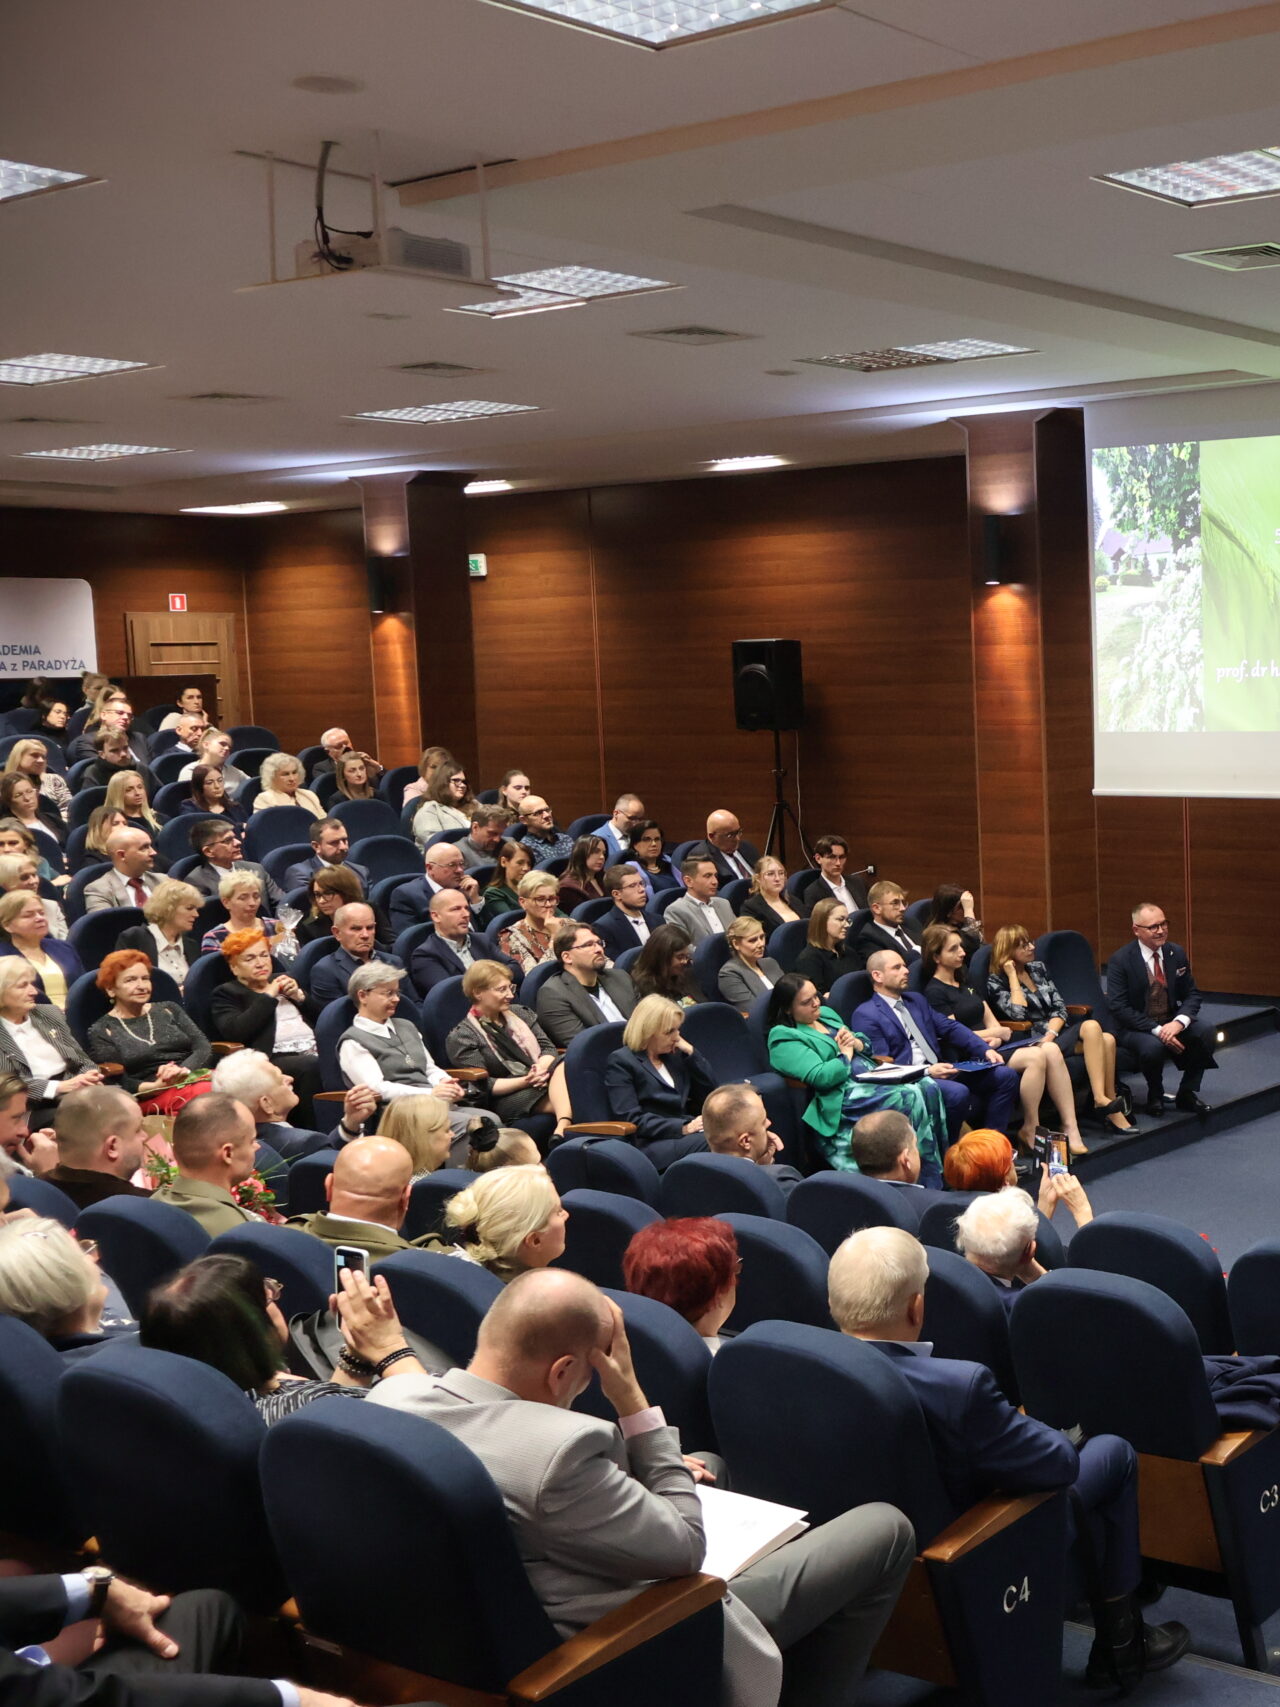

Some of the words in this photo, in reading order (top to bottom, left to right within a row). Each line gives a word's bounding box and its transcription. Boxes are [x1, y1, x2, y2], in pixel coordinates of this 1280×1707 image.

[0, 644, 41, 656] DEMIA
[22, 657, 86, 672] PARADYŻA
[1216, 659, 1249, 683] prof.
[1251, 659, 1268, 678] dr
[1260, 1484, 1279, 1513] C3
[1003, 1576, 1030, 1614] C4
